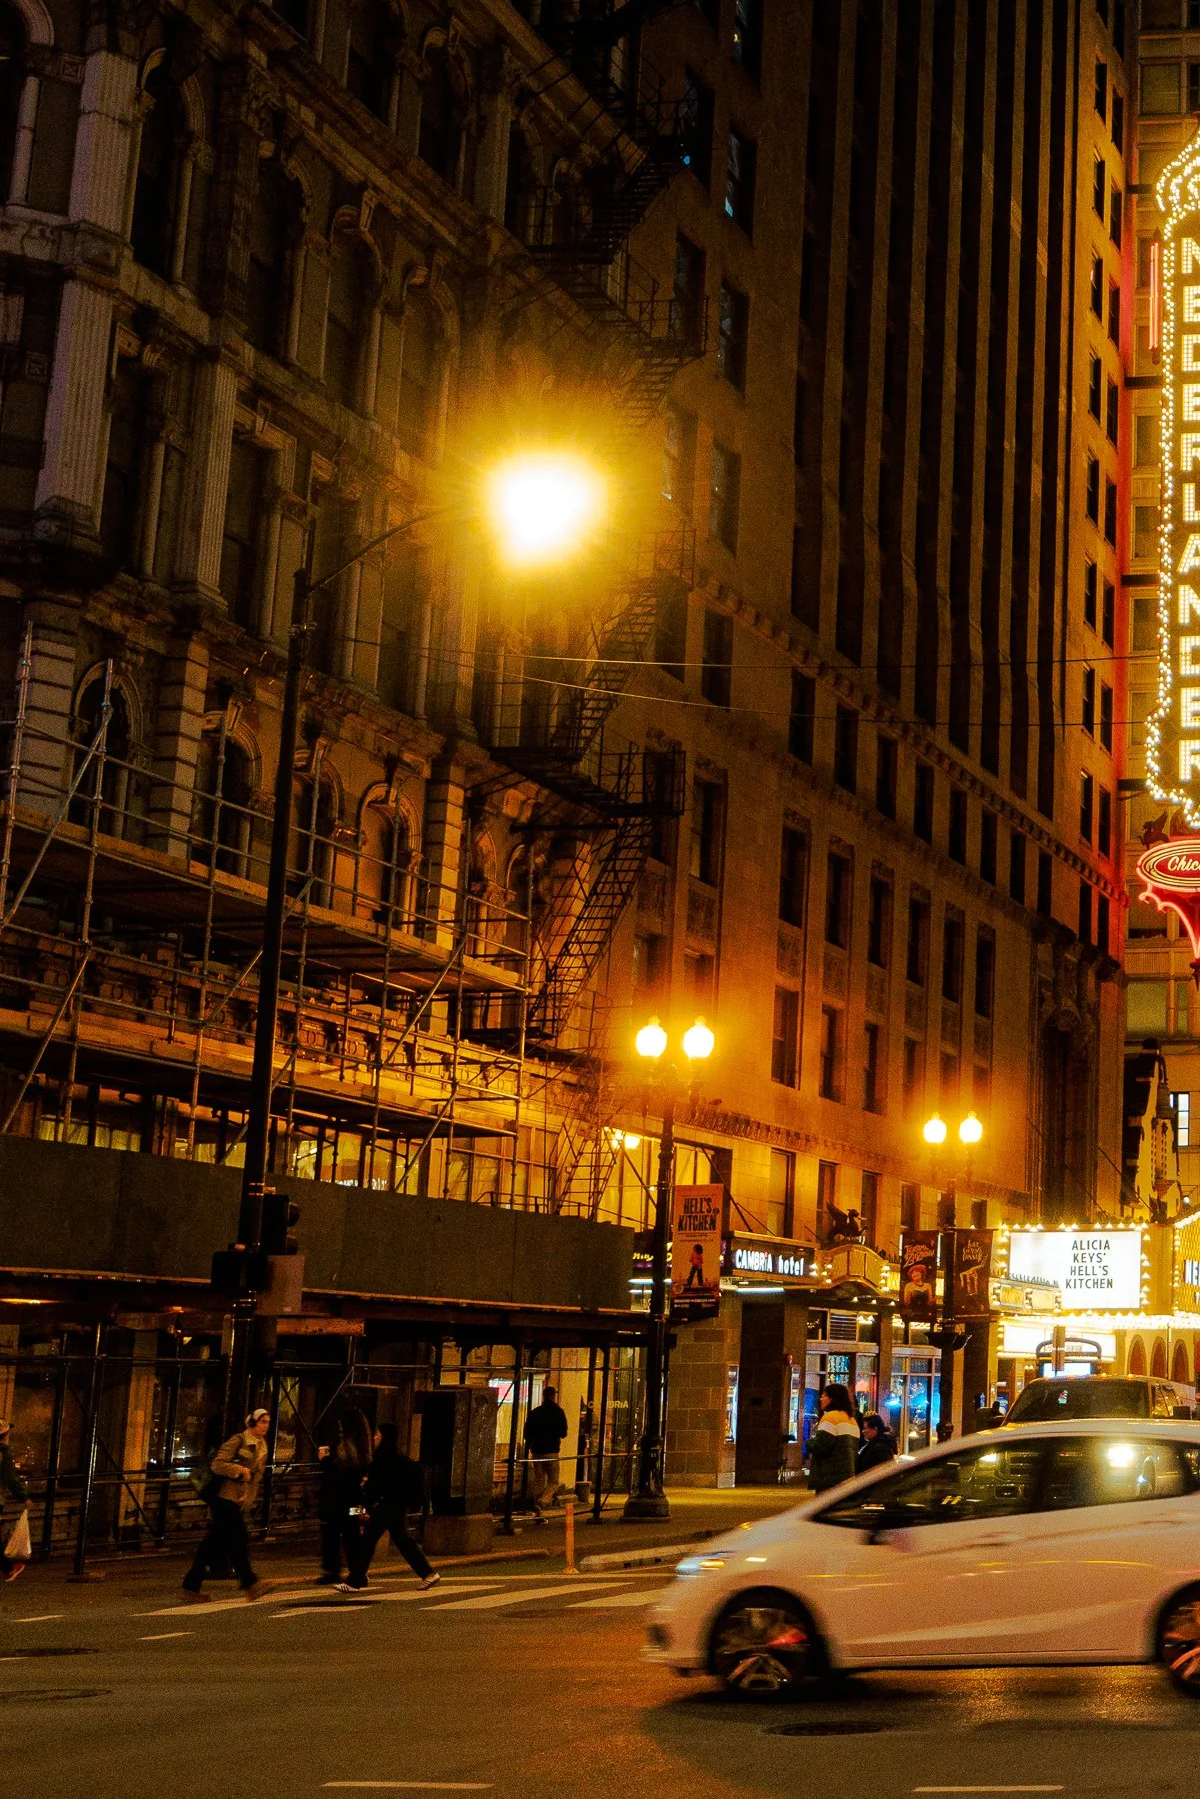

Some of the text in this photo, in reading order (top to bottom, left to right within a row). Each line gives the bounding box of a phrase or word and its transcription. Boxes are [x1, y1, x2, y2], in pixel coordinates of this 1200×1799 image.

[683, 1197, 712, 1215] HELL'S
[677, 1214, 717, 1232] KITCHEN
[1072, 1239, 1111, 1251] ALICIA
[1073, 1252, 1107, 1263] KEYS'
[778, 1254, 804, 1276] hotel
[1070, 1265, 1109, 1277] HELL'S
[1065, 1278, 1113, 1289] KITCHEN
